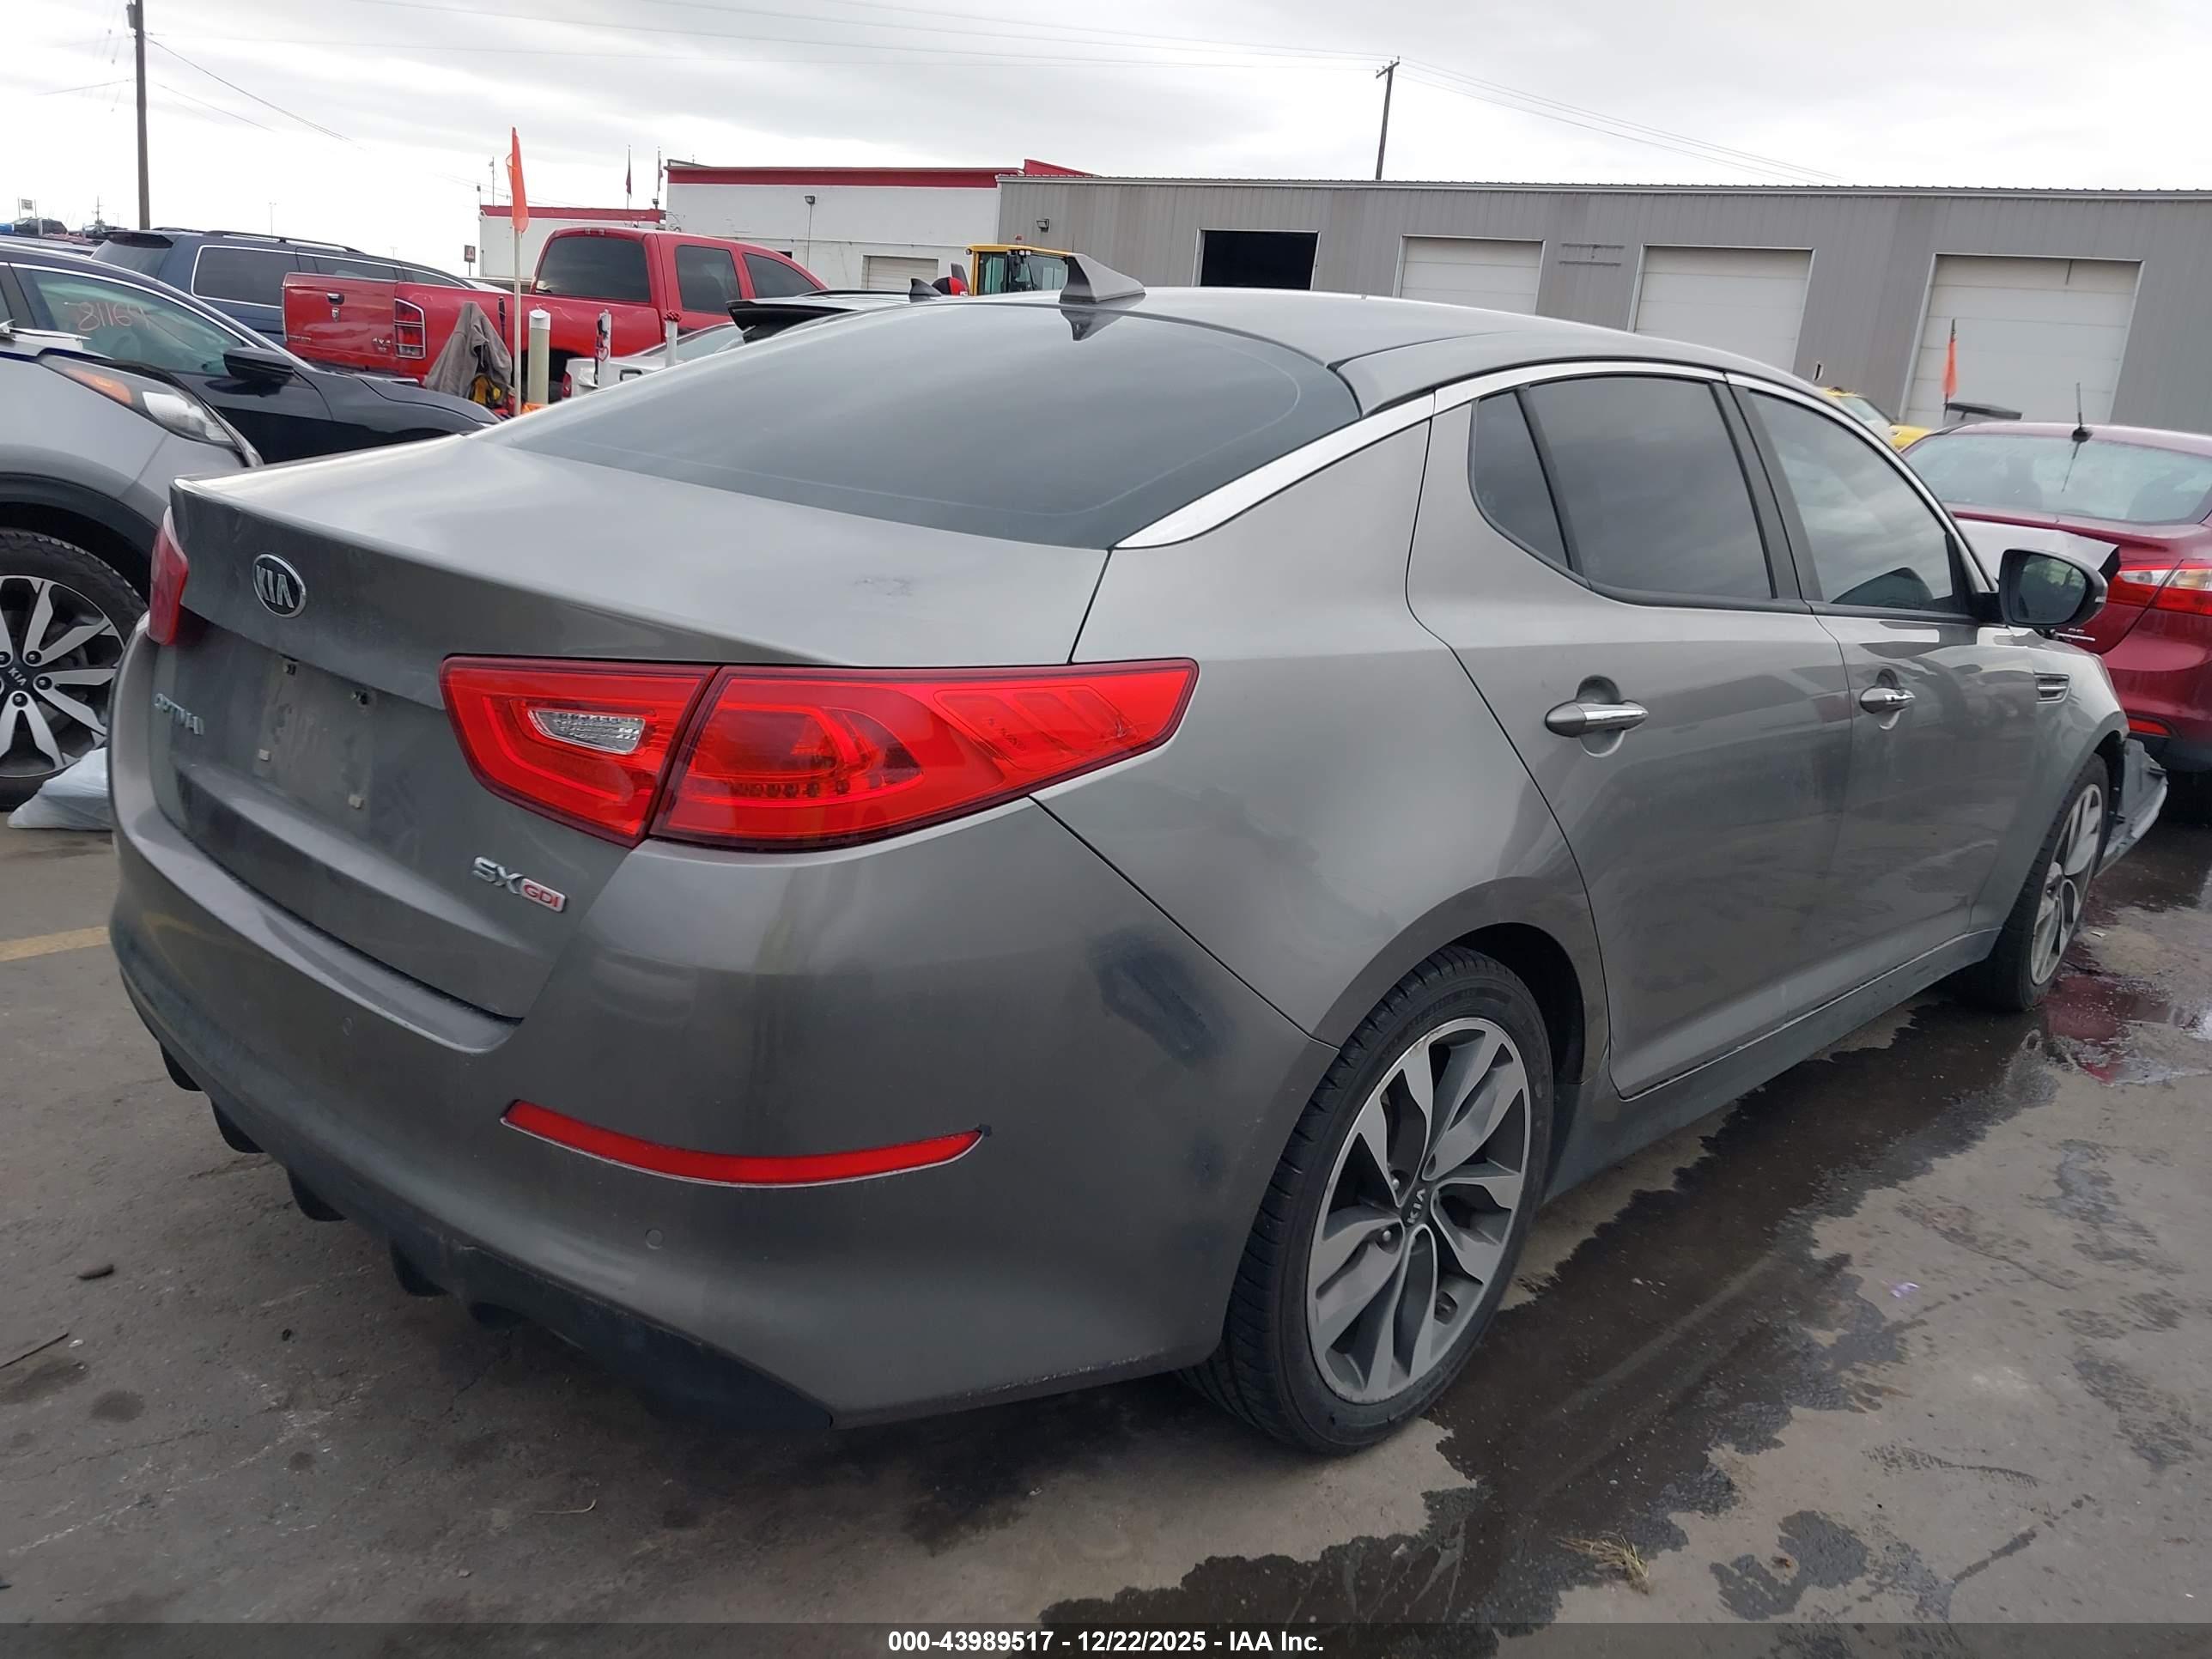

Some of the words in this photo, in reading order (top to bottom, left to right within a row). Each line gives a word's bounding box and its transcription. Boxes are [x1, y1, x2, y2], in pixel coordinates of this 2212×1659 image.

[256, 564, 295, 609] KIA
[8, 667, 27, 687] KIA
[1407, 1188, 1426, 1224] KIA
